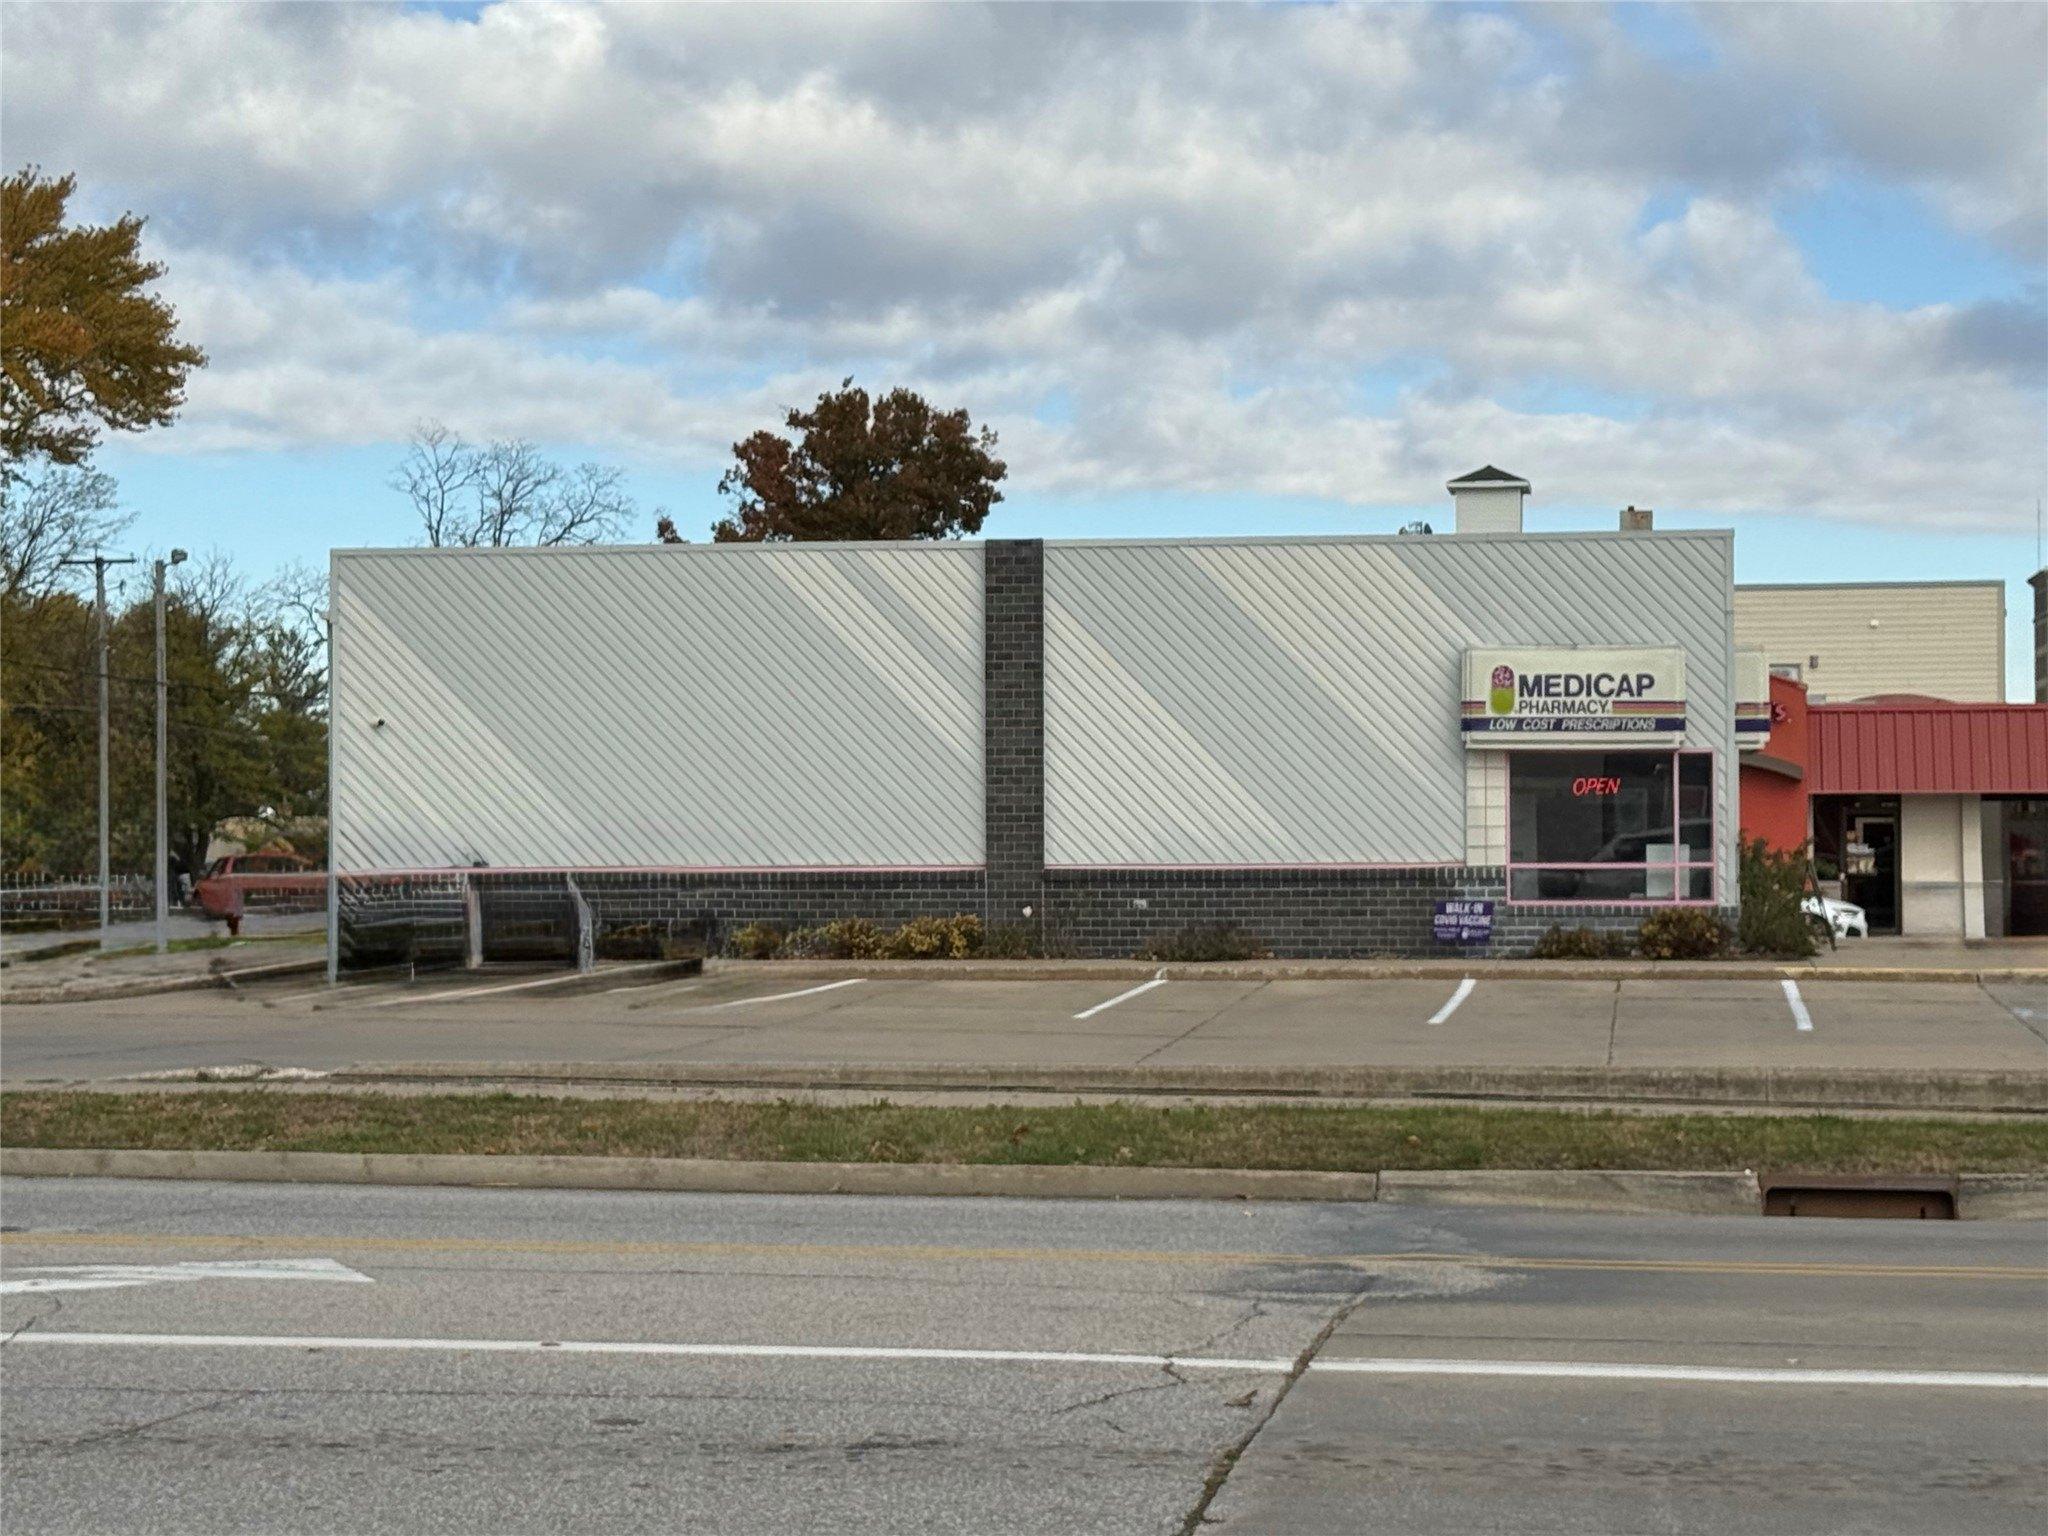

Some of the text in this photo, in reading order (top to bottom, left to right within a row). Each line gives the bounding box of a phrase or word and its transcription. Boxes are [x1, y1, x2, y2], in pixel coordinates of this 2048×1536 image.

[1518, 673, 1655, 698] MEDICAP
[1518, 699, 1609, 715] PHARMACY
[1489, 718, 1656, 731] LOW COST PRESCRIPTIONS
[1572, 777, 1621, 796] OPEN
